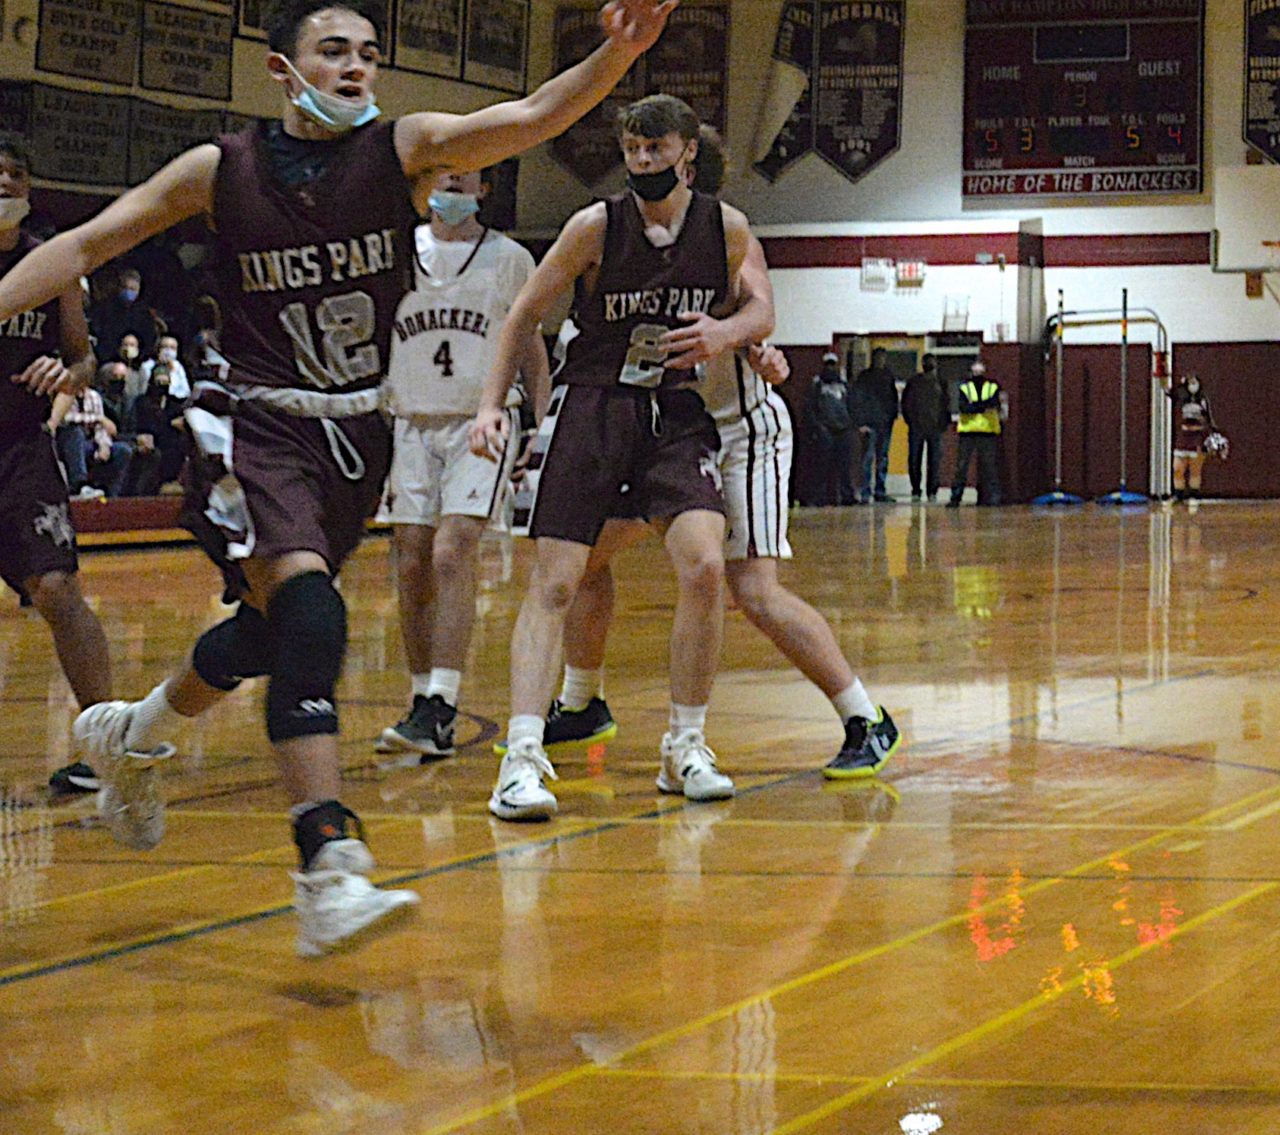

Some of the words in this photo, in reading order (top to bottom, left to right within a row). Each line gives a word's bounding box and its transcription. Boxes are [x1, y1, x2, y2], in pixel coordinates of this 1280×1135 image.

[982, 66, 1021, 81] HOME
[1138, 60, 1182, 77] GUEST
[966, 175, 1017, 194] HOME
[1023, 174, 1049, 192] OF
[1053, 172, 1085, 191] THE
[1090, 168, 1193, 192] BONACKERS
[238, 244, 323, 292] KINGS
[603, 287, 664, 323] KINGS
[278, 290, 381, 389] 12
[433, 341, 454, 377] 4
